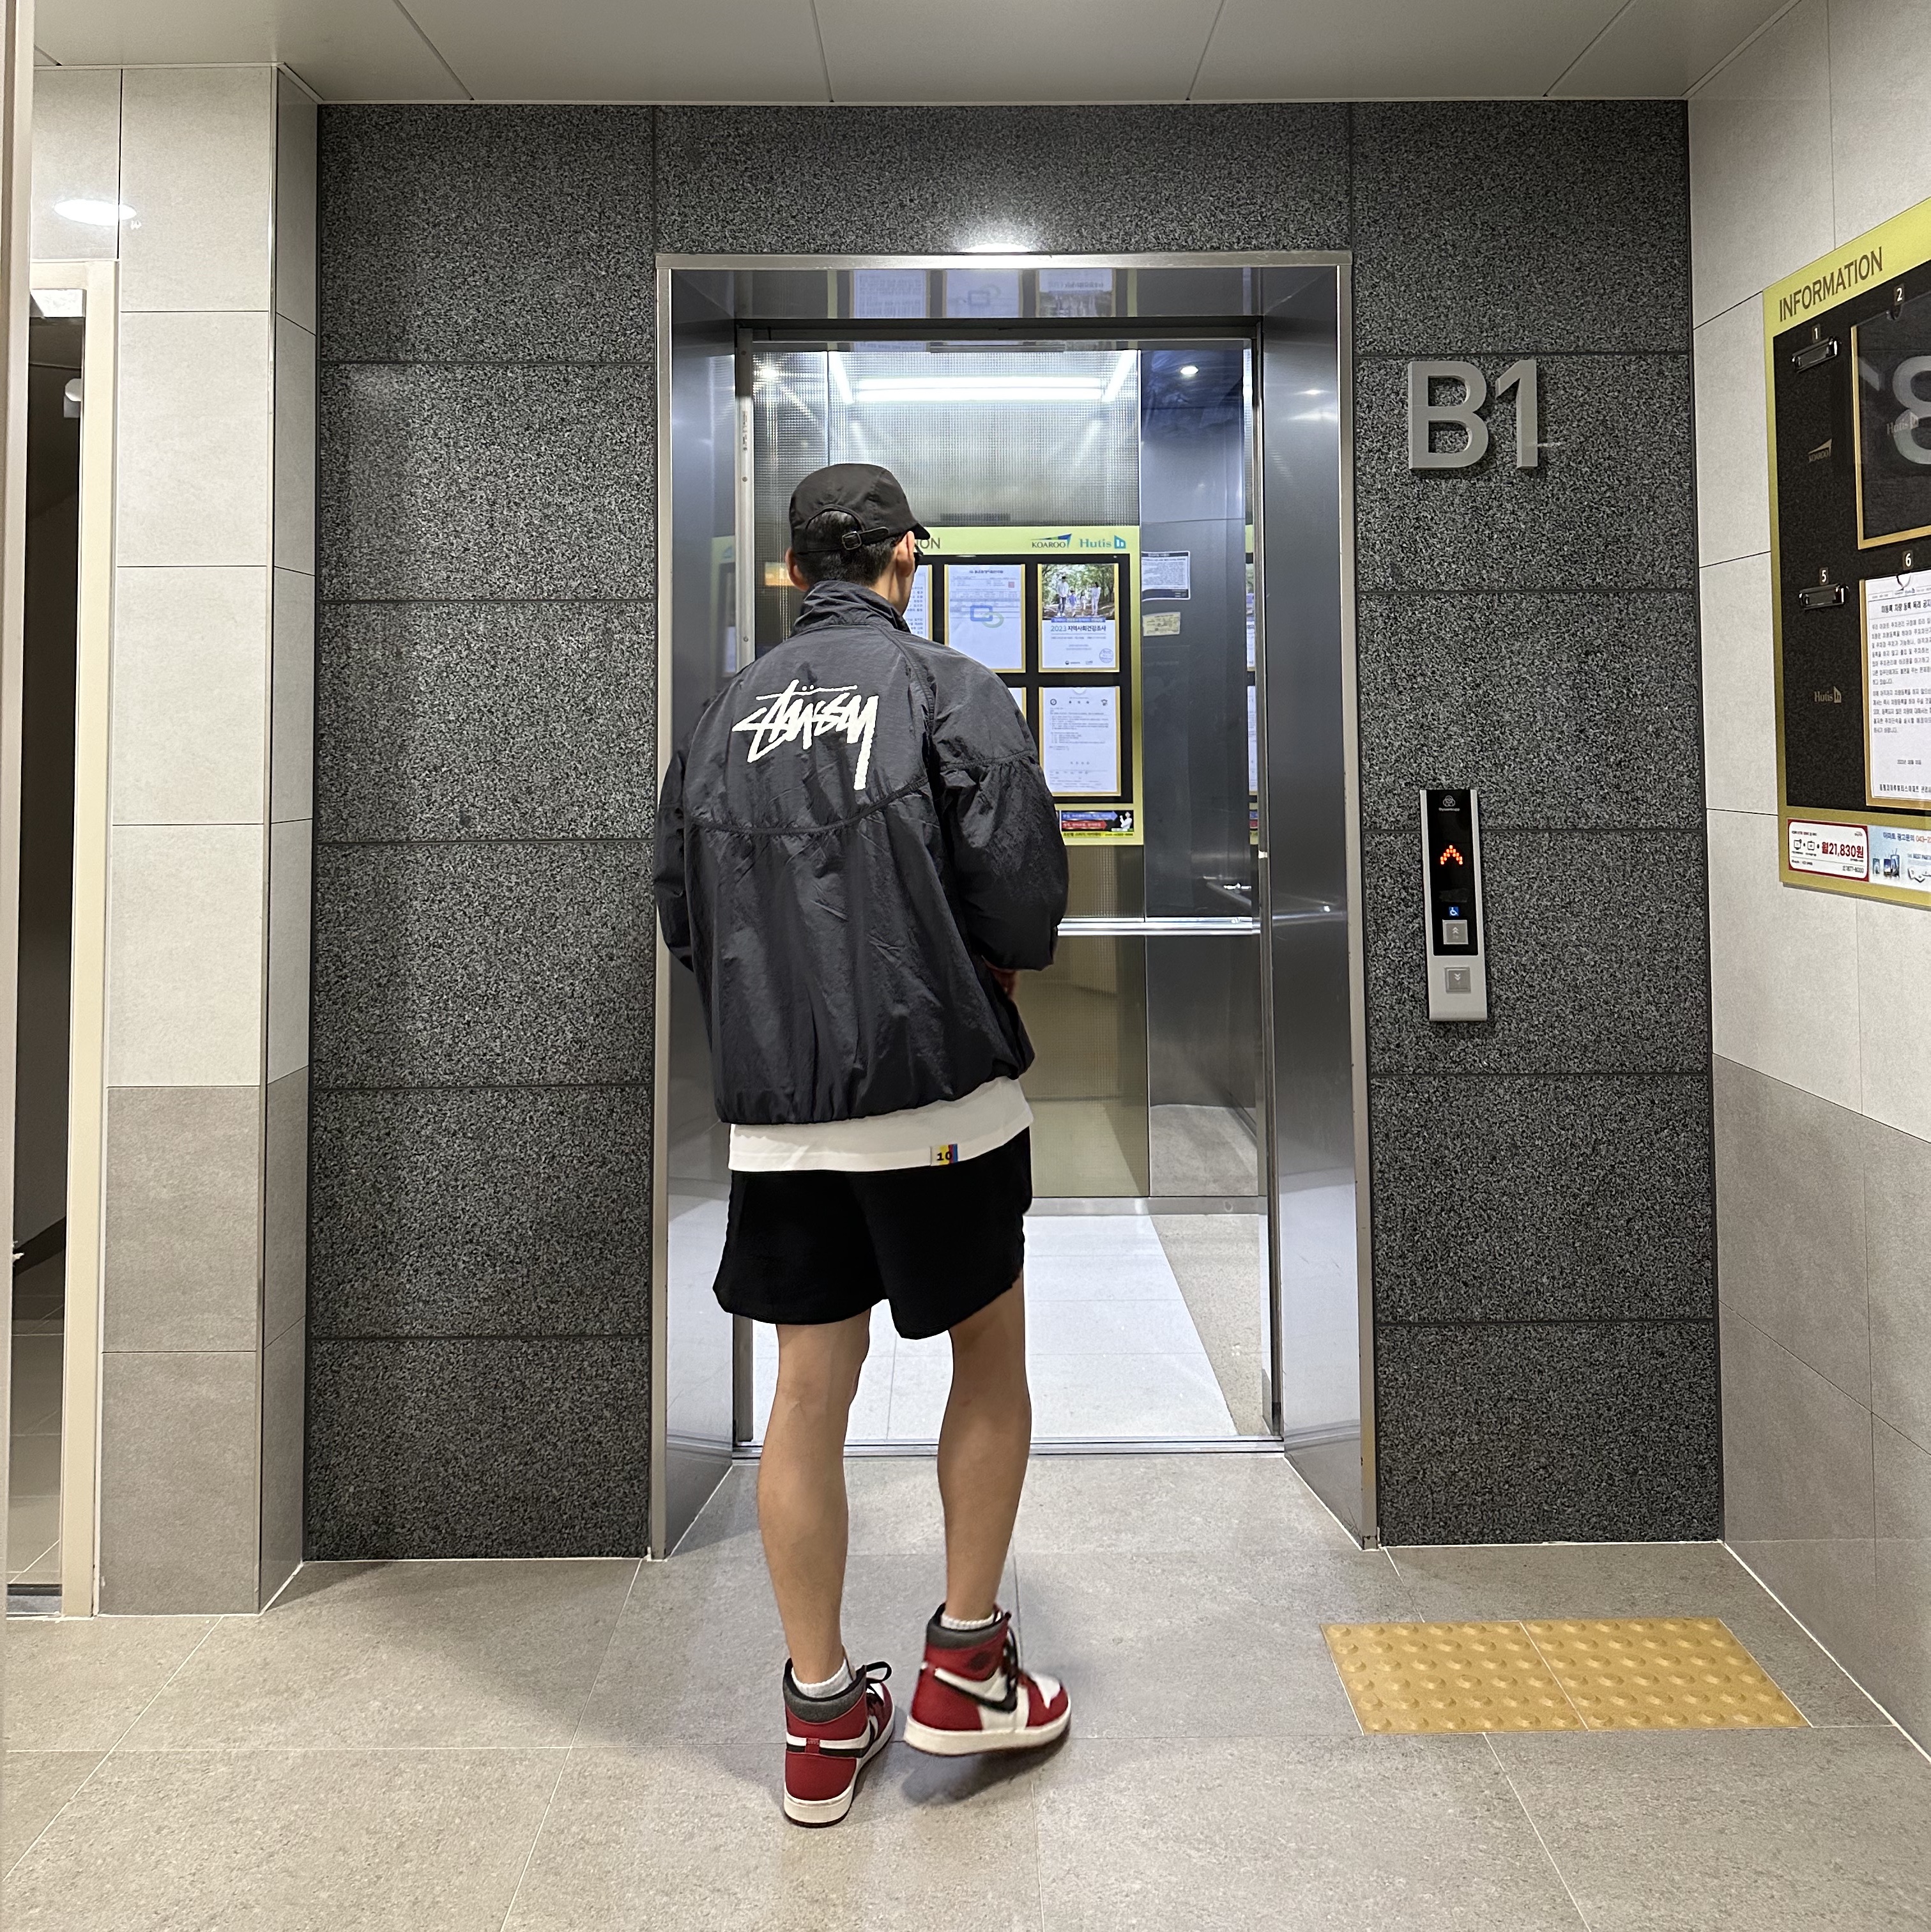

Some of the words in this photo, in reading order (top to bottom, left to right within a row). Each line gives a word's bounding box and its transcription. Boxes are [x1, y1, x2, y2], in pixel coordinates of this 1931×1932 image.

[1780, 247, 1882, 322] INFORMATION
[1897, 288, 1903, 302] 2
[1813, 327, 1819, 340] 1
[1408, 360, 1538, 470] B1
[1080, 539, 1111, 548] Hutis
[1905, 553, 1911, 567] 6
[1821, 570, 1826, 582] 5
[937, 1151, 952, 1161] 10
